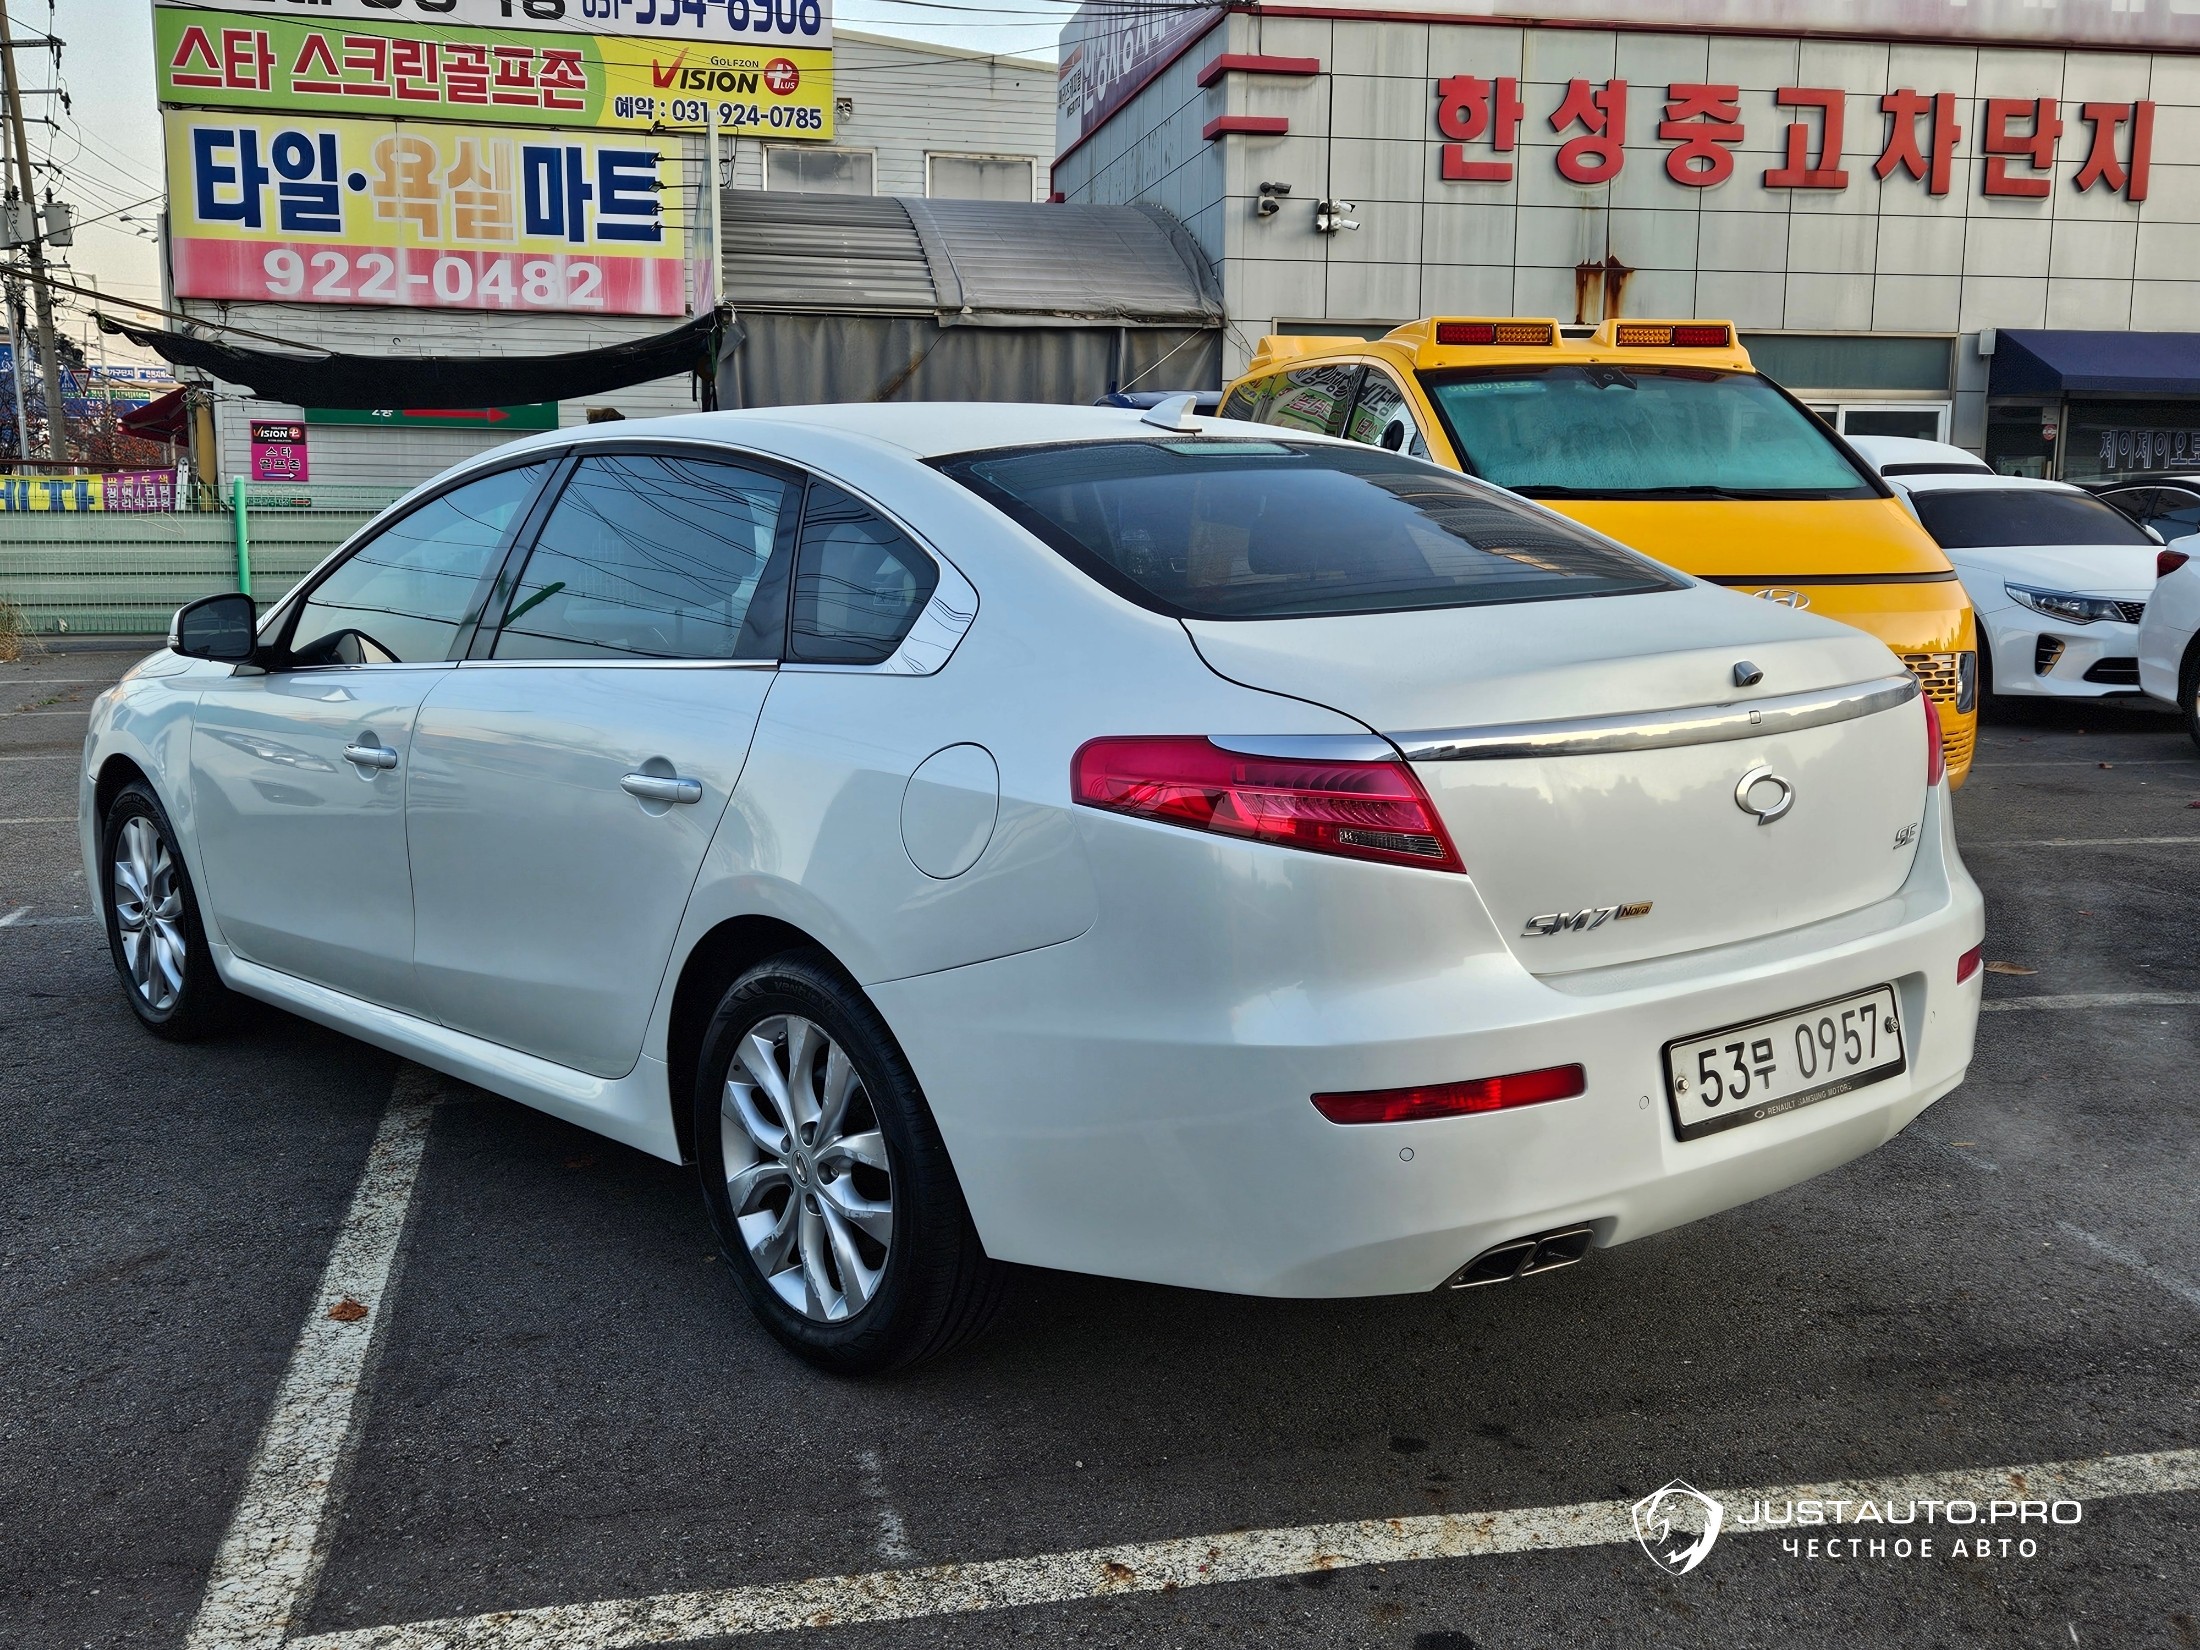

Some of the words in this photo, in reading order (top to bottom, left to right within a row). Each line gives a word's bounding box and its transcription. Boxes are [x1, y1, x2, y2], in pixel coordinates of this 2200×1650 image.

[170, 25, 277, 91] 스타
[290, 32, 587, 111] 스크린골프존
[652, 47, 759, 94] VISION
[710, 55, 759, 68] GOLFZON
[614, 96, 654, 119] 예약
[672, 99, 822, 130] 031924-0785
[1437, 74, 2156, 202] 한성중고차단지
[263, 248, 604, 306] 922-0482
[253, 426, 288, 438] VISION
[259, 458, 300, 470] 골프존
[1521, 904, 1618, 938] SM7
[1620, 902, 1652, 917] Nova
[1698, 1037, 1776, 1107] 53무
[1795, 1003, 1878, 1079] 0957
[1767, 1100, 1795, 1115] RENAULT
[1798, 1090, 1827, 1106] SAMSUNG
[1827, 1083, 1852, 1099] MOTORS
